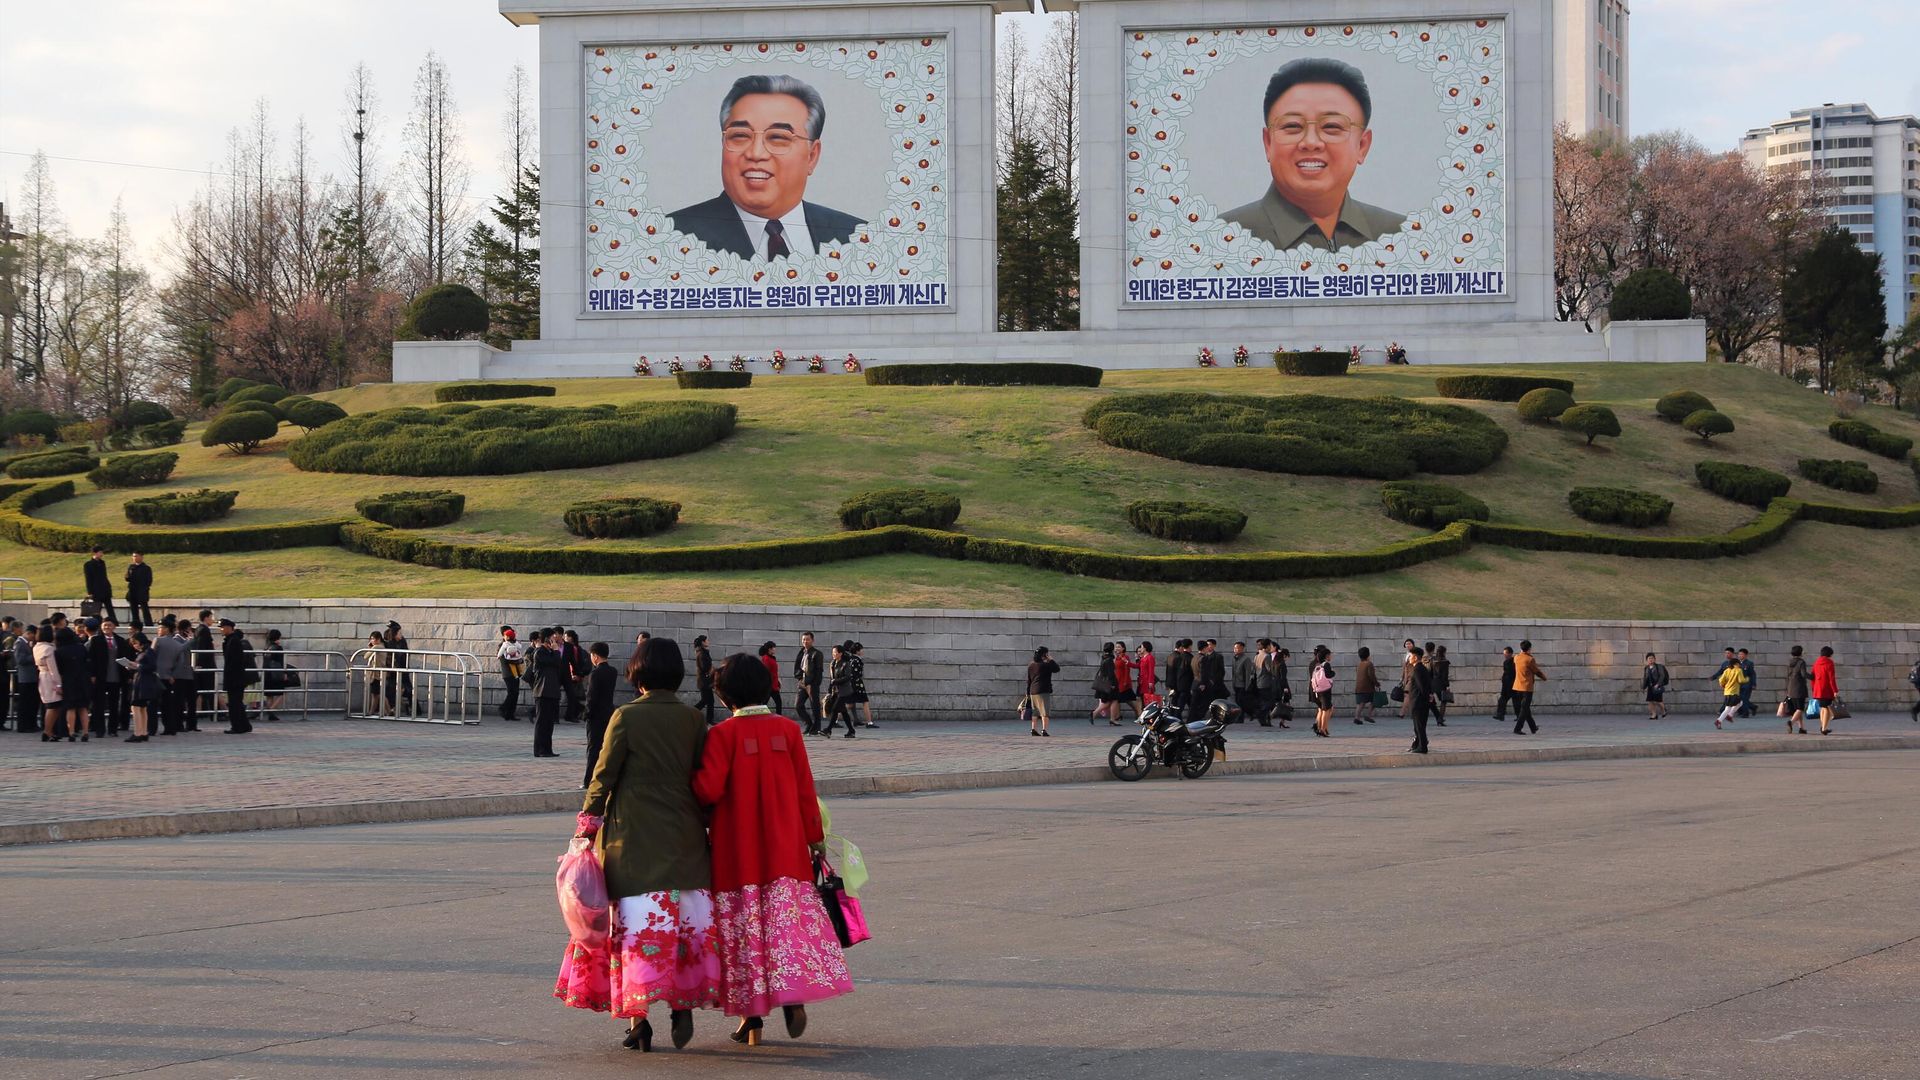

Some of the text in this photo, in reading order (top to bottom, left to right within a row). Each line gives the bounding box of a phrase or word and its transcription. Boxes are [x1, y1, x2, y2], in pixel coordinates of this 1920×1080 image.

[589, 283, 947, 310] 위대한 수령 김일성동지는 영원히 우리와 함께 계신다
[1128, 271, 1503, 301] 위대한 령도자 김정일동지는 영원히 우리와 함께 계신다
